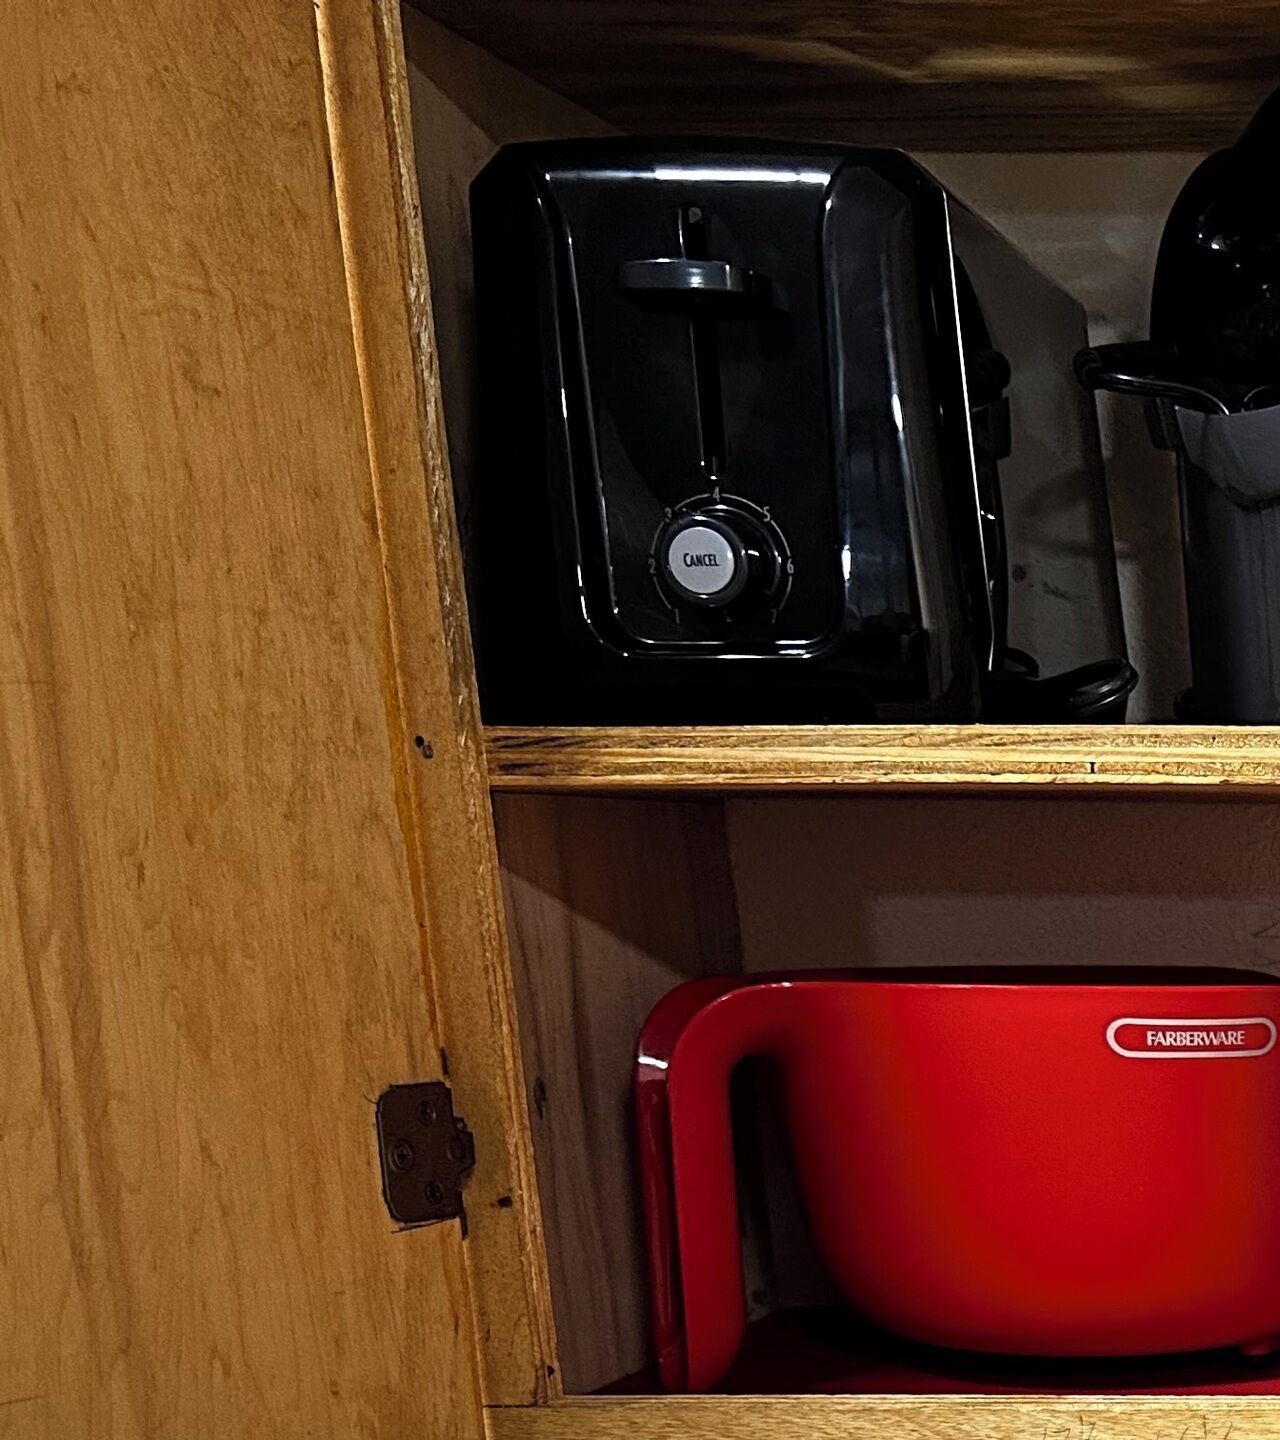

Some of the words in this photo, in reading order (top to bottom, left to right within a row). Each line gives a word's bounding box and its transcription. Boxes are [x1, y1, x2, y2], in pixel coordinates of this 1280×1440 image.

[763, 506, 771, 521] 5
[787, 558, 795, 574] 6
[1146, 1030, 1246, 1047] FARBERWARE
